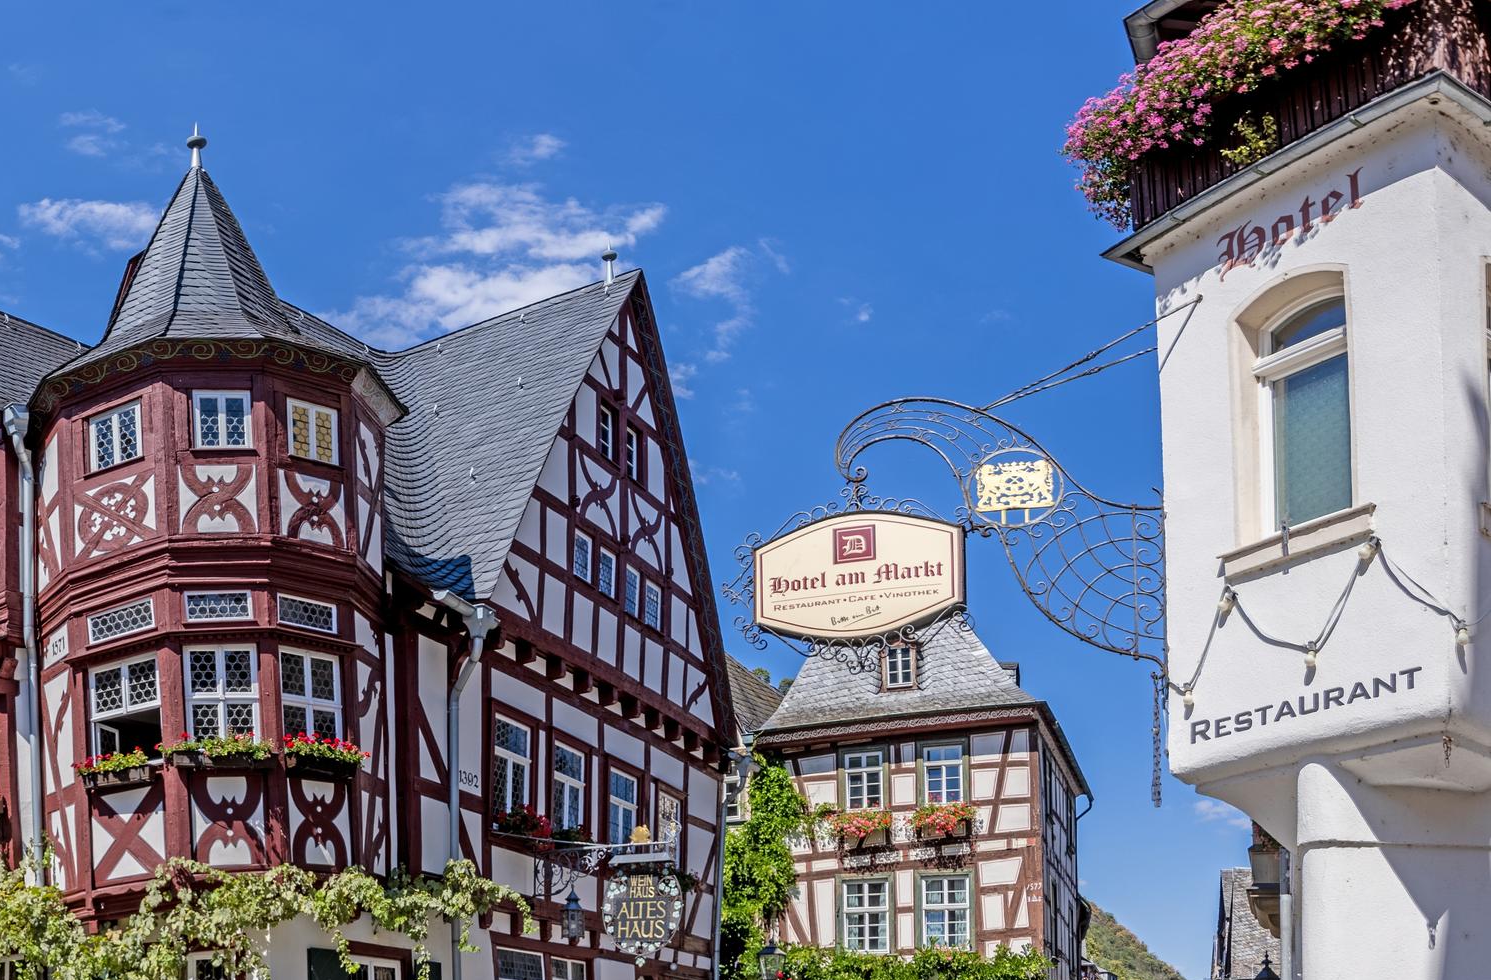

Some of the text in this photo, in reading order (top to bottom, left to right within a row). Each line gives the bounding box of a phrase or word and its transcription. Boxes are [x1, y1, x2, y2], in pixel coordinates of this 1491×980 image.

[1217, 166, 1364, 282] Hotel
[769, 561, 944, 597] Hotel am Markt
[773, 598, 841, 612] RESTAURANT
[1190, 666, 1423, 745] RESTAURANT
[459, 769, 479, 789] 1392
[630, 874, 653, 887] WEIN
[629, 886, 655, 899] HAUS
[617, 900, 667, 919] ALTES
[617, 920, 666, 939] HAUS
